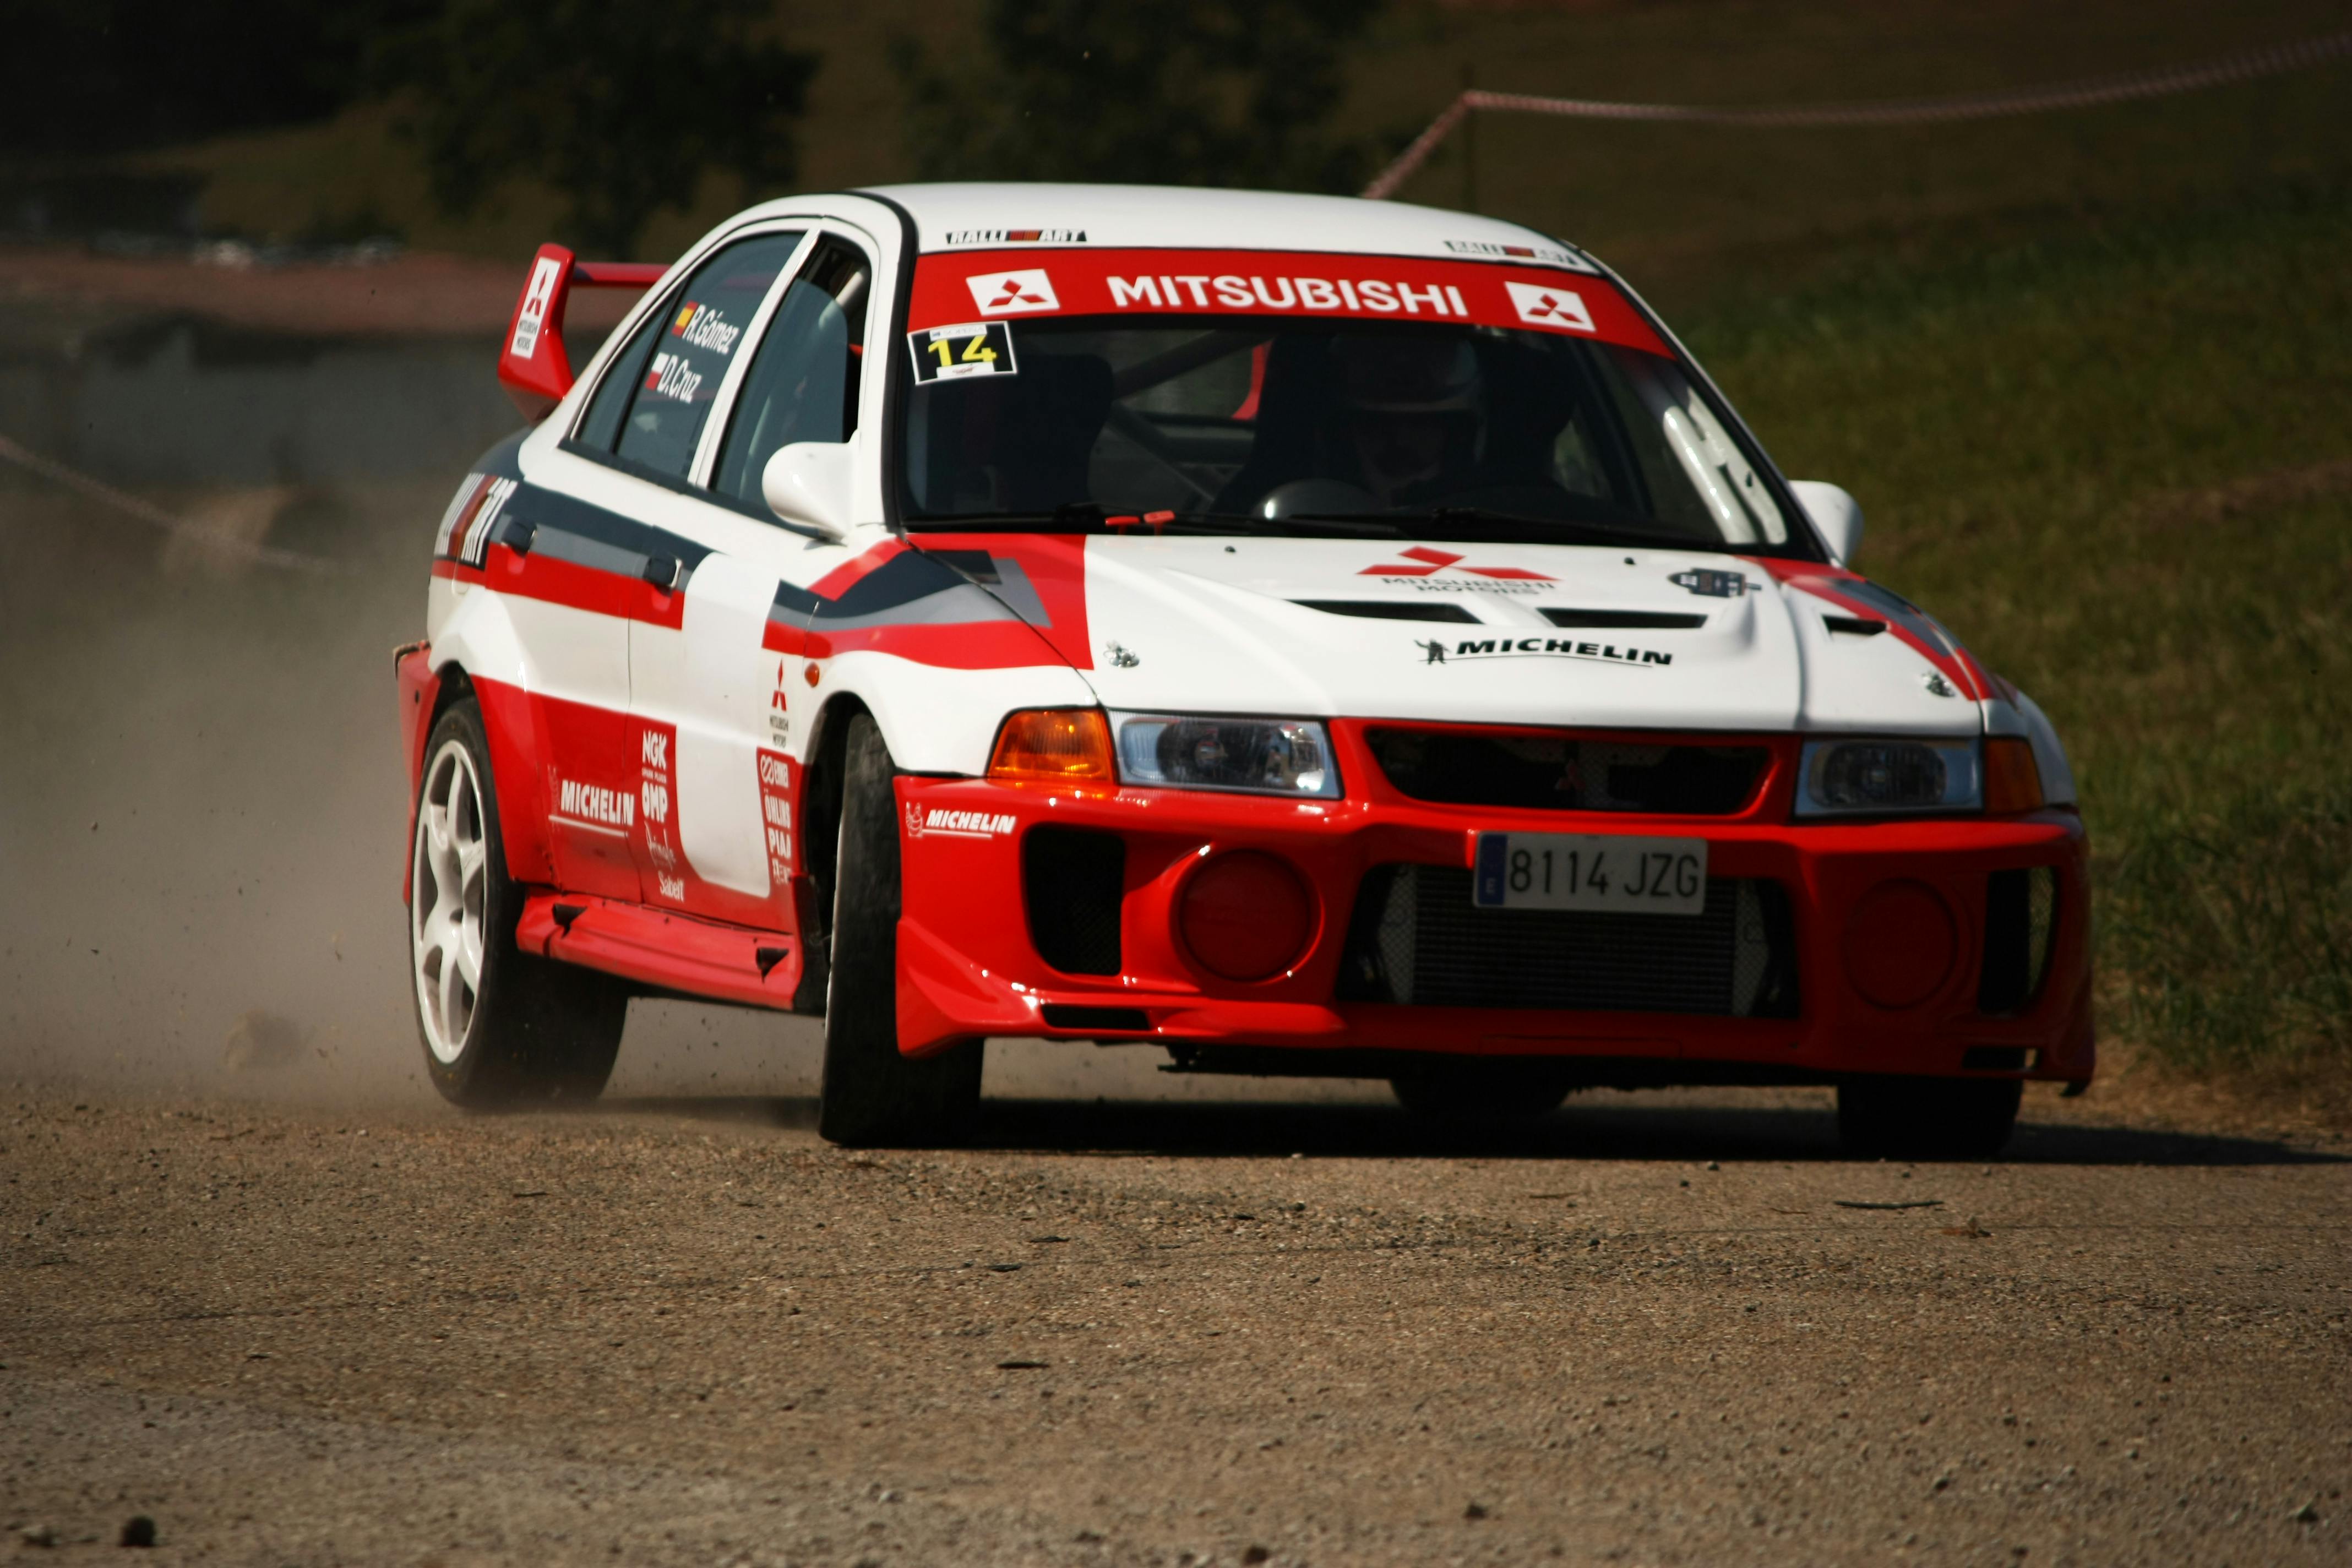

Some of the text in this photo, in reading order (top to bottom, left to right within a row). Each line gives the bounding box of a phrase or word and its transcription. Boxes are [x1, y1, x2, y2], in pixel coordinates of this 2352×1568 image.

[949, 230, 1080, 244] RALLI ART
[1106, 276, 1468, 316] MITSUBISHI
[682, 304, 739, 355] R.Gómez
[928, 335, 998, 368] 14
[657, 355, 703, 404] D.Cruz
[1381, 578, 1556, 589] MITSUBISHI
[1457, 638, 1673, 666] MICHELIN
[642, 729, 667, 771] NGK
[560, 779, 634, 827] MICHELIN
[641, 781, 668, 823] OMP
[925, 809, 1016, 834] MICHELIN
[658, 870, 684, 903] Sabelt
[1485, 876, 1497, 895] E
[1510, 849, 1699, 898] 8114 JZG
